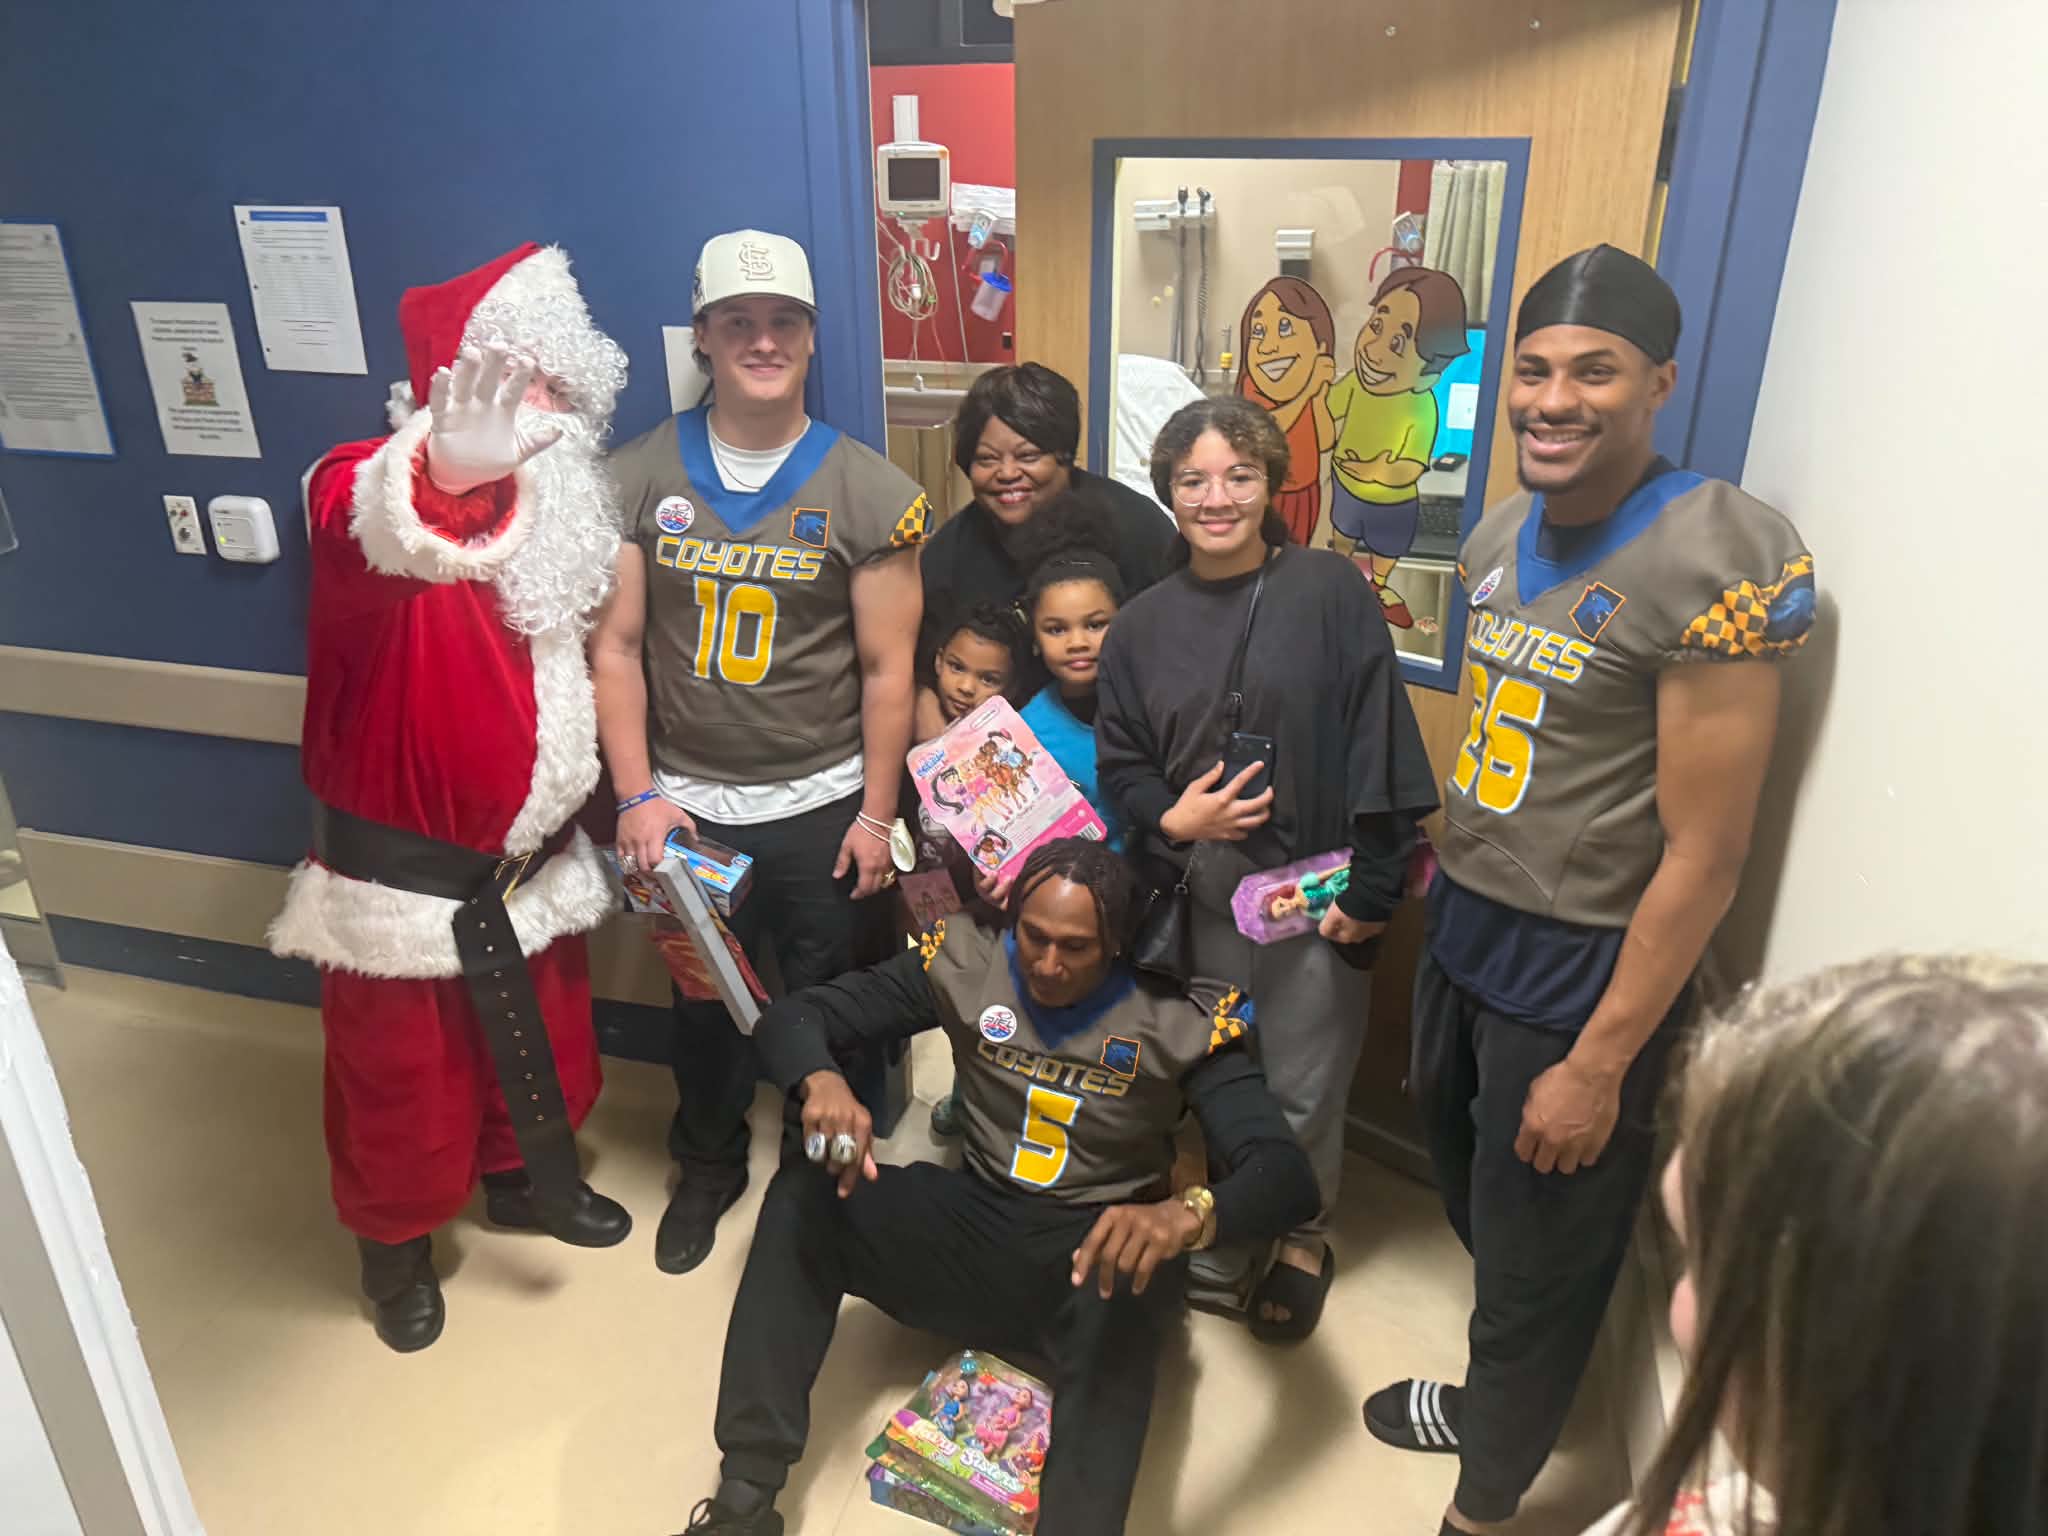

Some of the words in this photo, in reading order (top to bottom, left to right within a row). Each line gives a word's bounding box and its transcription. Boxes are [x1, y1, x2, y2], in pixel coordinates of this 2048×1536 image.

[655, 534, 827, 581] COYOTES
[692, 574, 778, 687] 10
[1469, 610, 1597, 684] OYOTES
[977, 1038, 1136, 1097] COYOTES
[1009, 1083, 1085, 1188] 5
